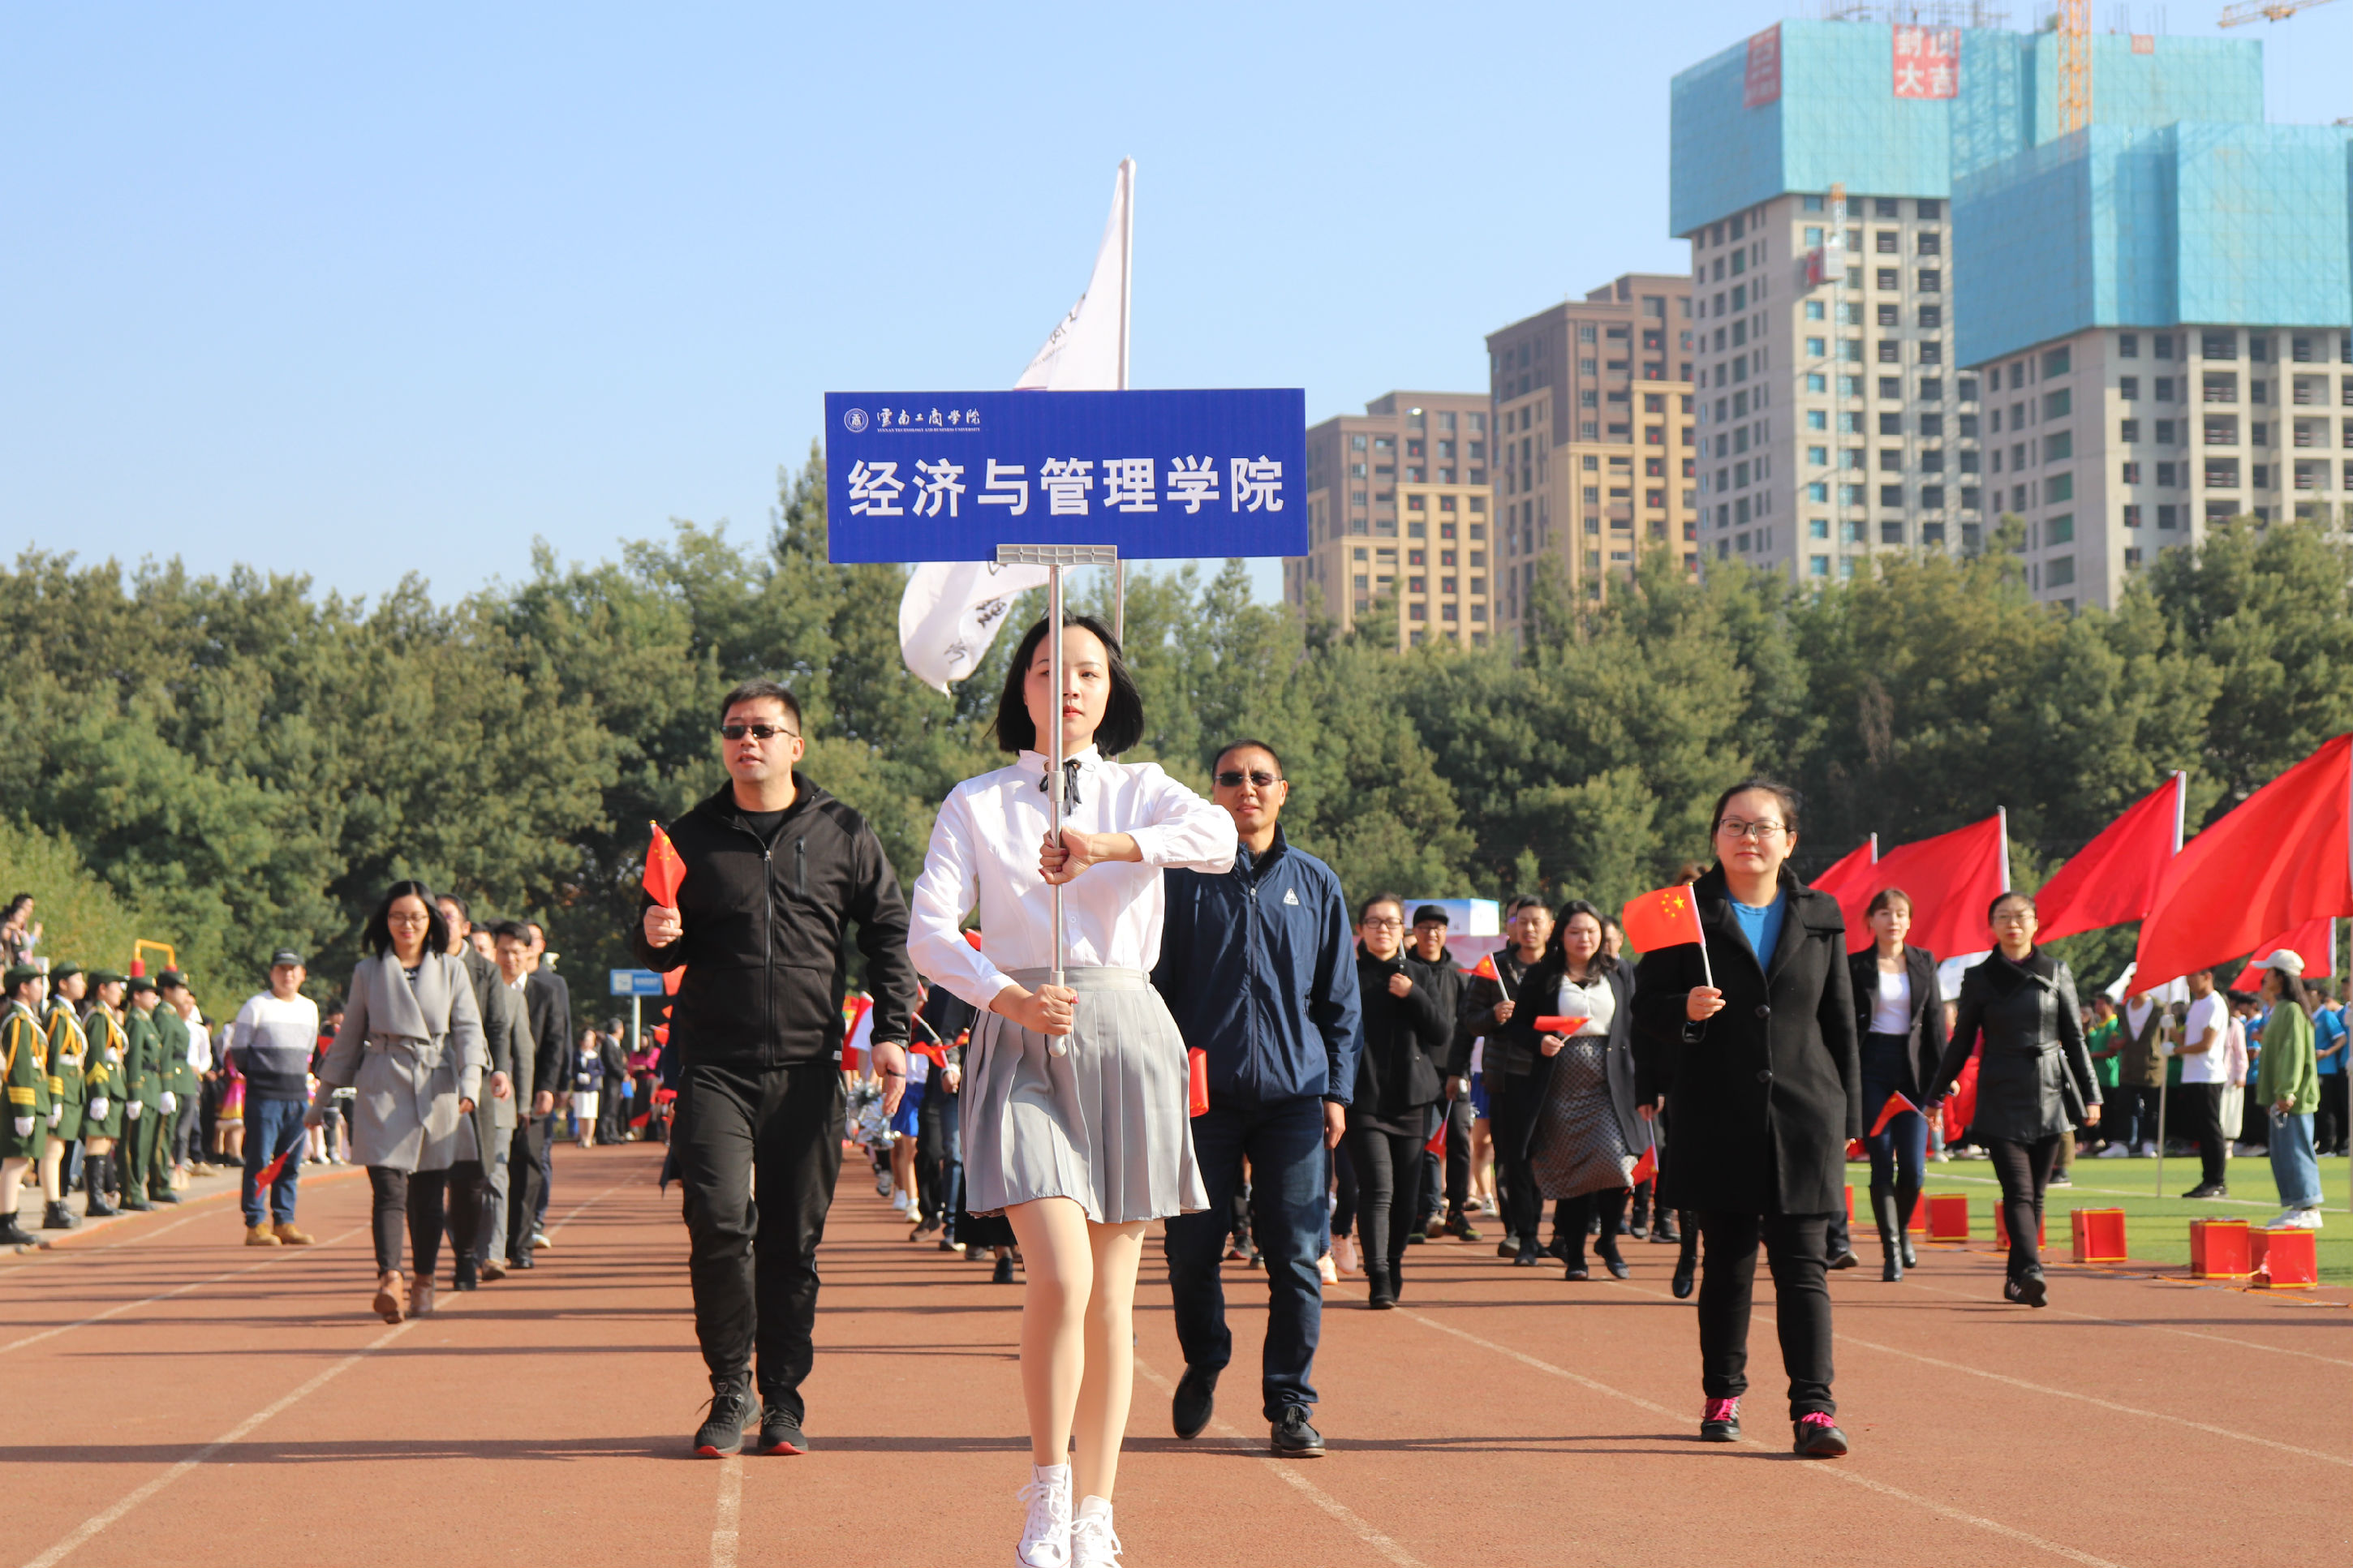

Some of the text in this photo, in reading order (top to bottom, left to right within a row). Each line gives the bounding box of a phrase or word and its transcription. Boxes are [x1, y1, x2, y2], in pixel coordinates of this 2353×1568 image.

[1896, 61, 1955, 95] 大吉
[848, 454, 1284, 518] 经济与管理学院
